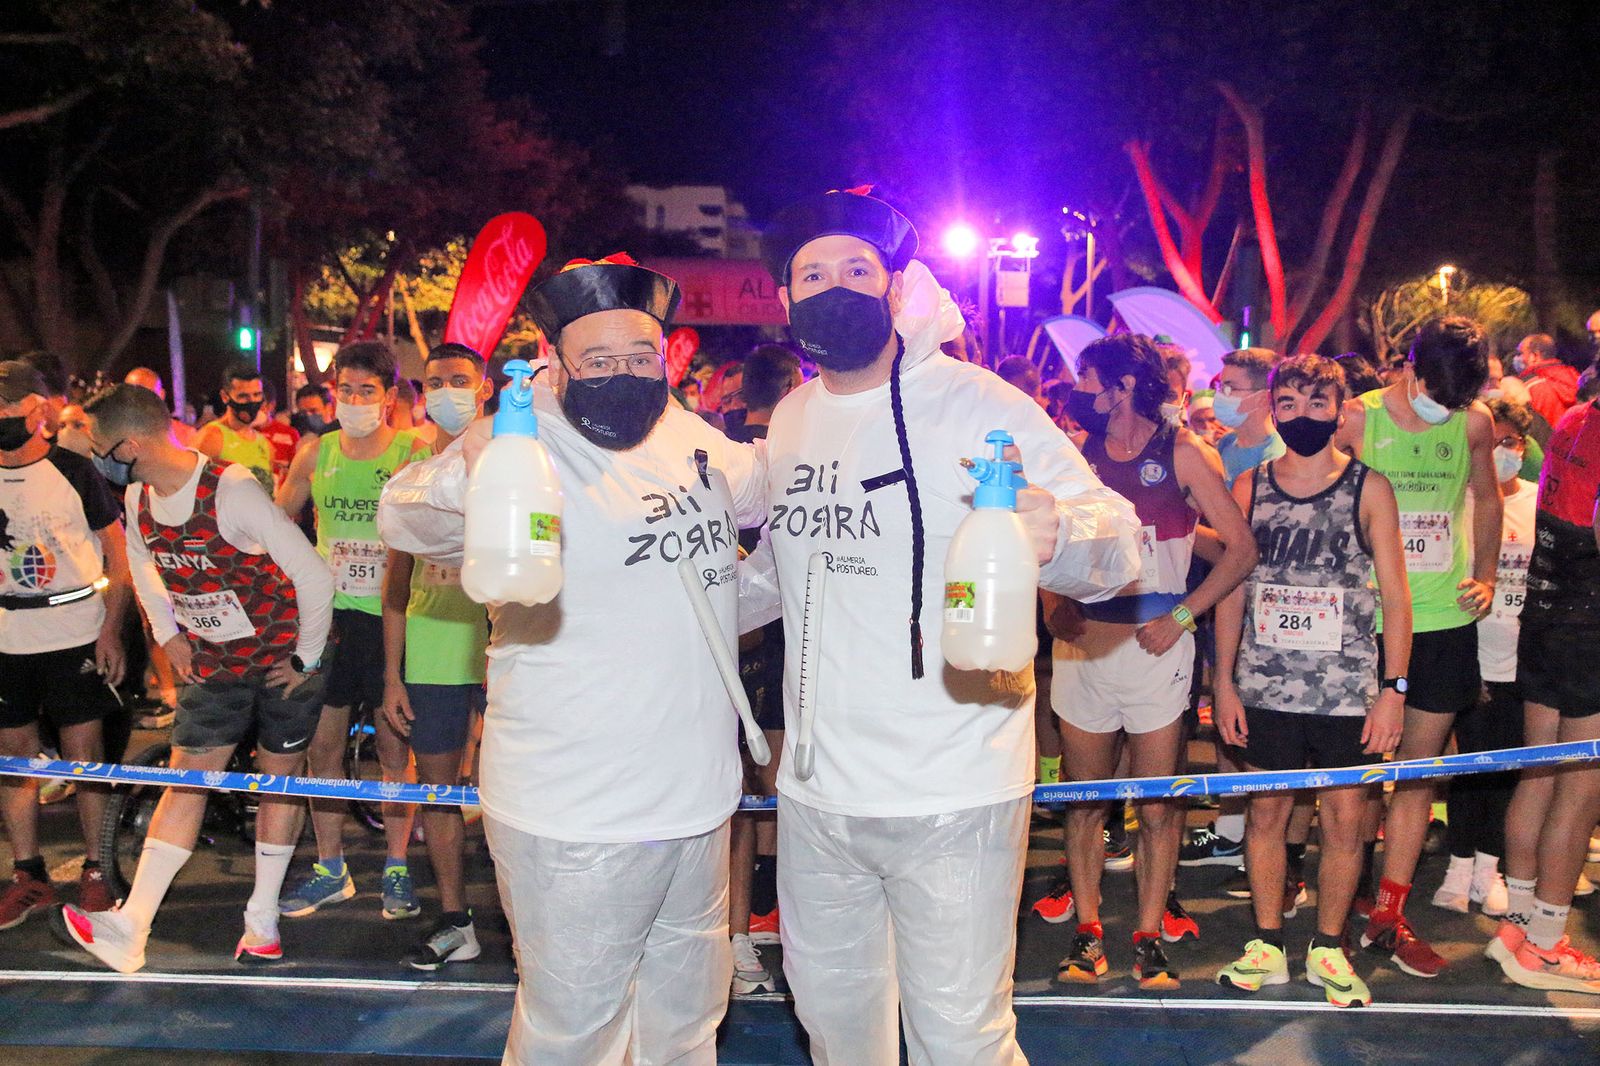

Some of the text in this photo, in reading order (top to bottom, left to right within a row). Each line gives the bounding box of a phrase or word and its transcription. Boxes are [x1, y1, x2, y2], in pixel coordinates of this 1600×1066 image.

[740, 278, 778, 299] AL
[348, 564, 376, 579] 551
[191, 615, 222, 629] 366
[1278, 613, 1313, 631] 284
